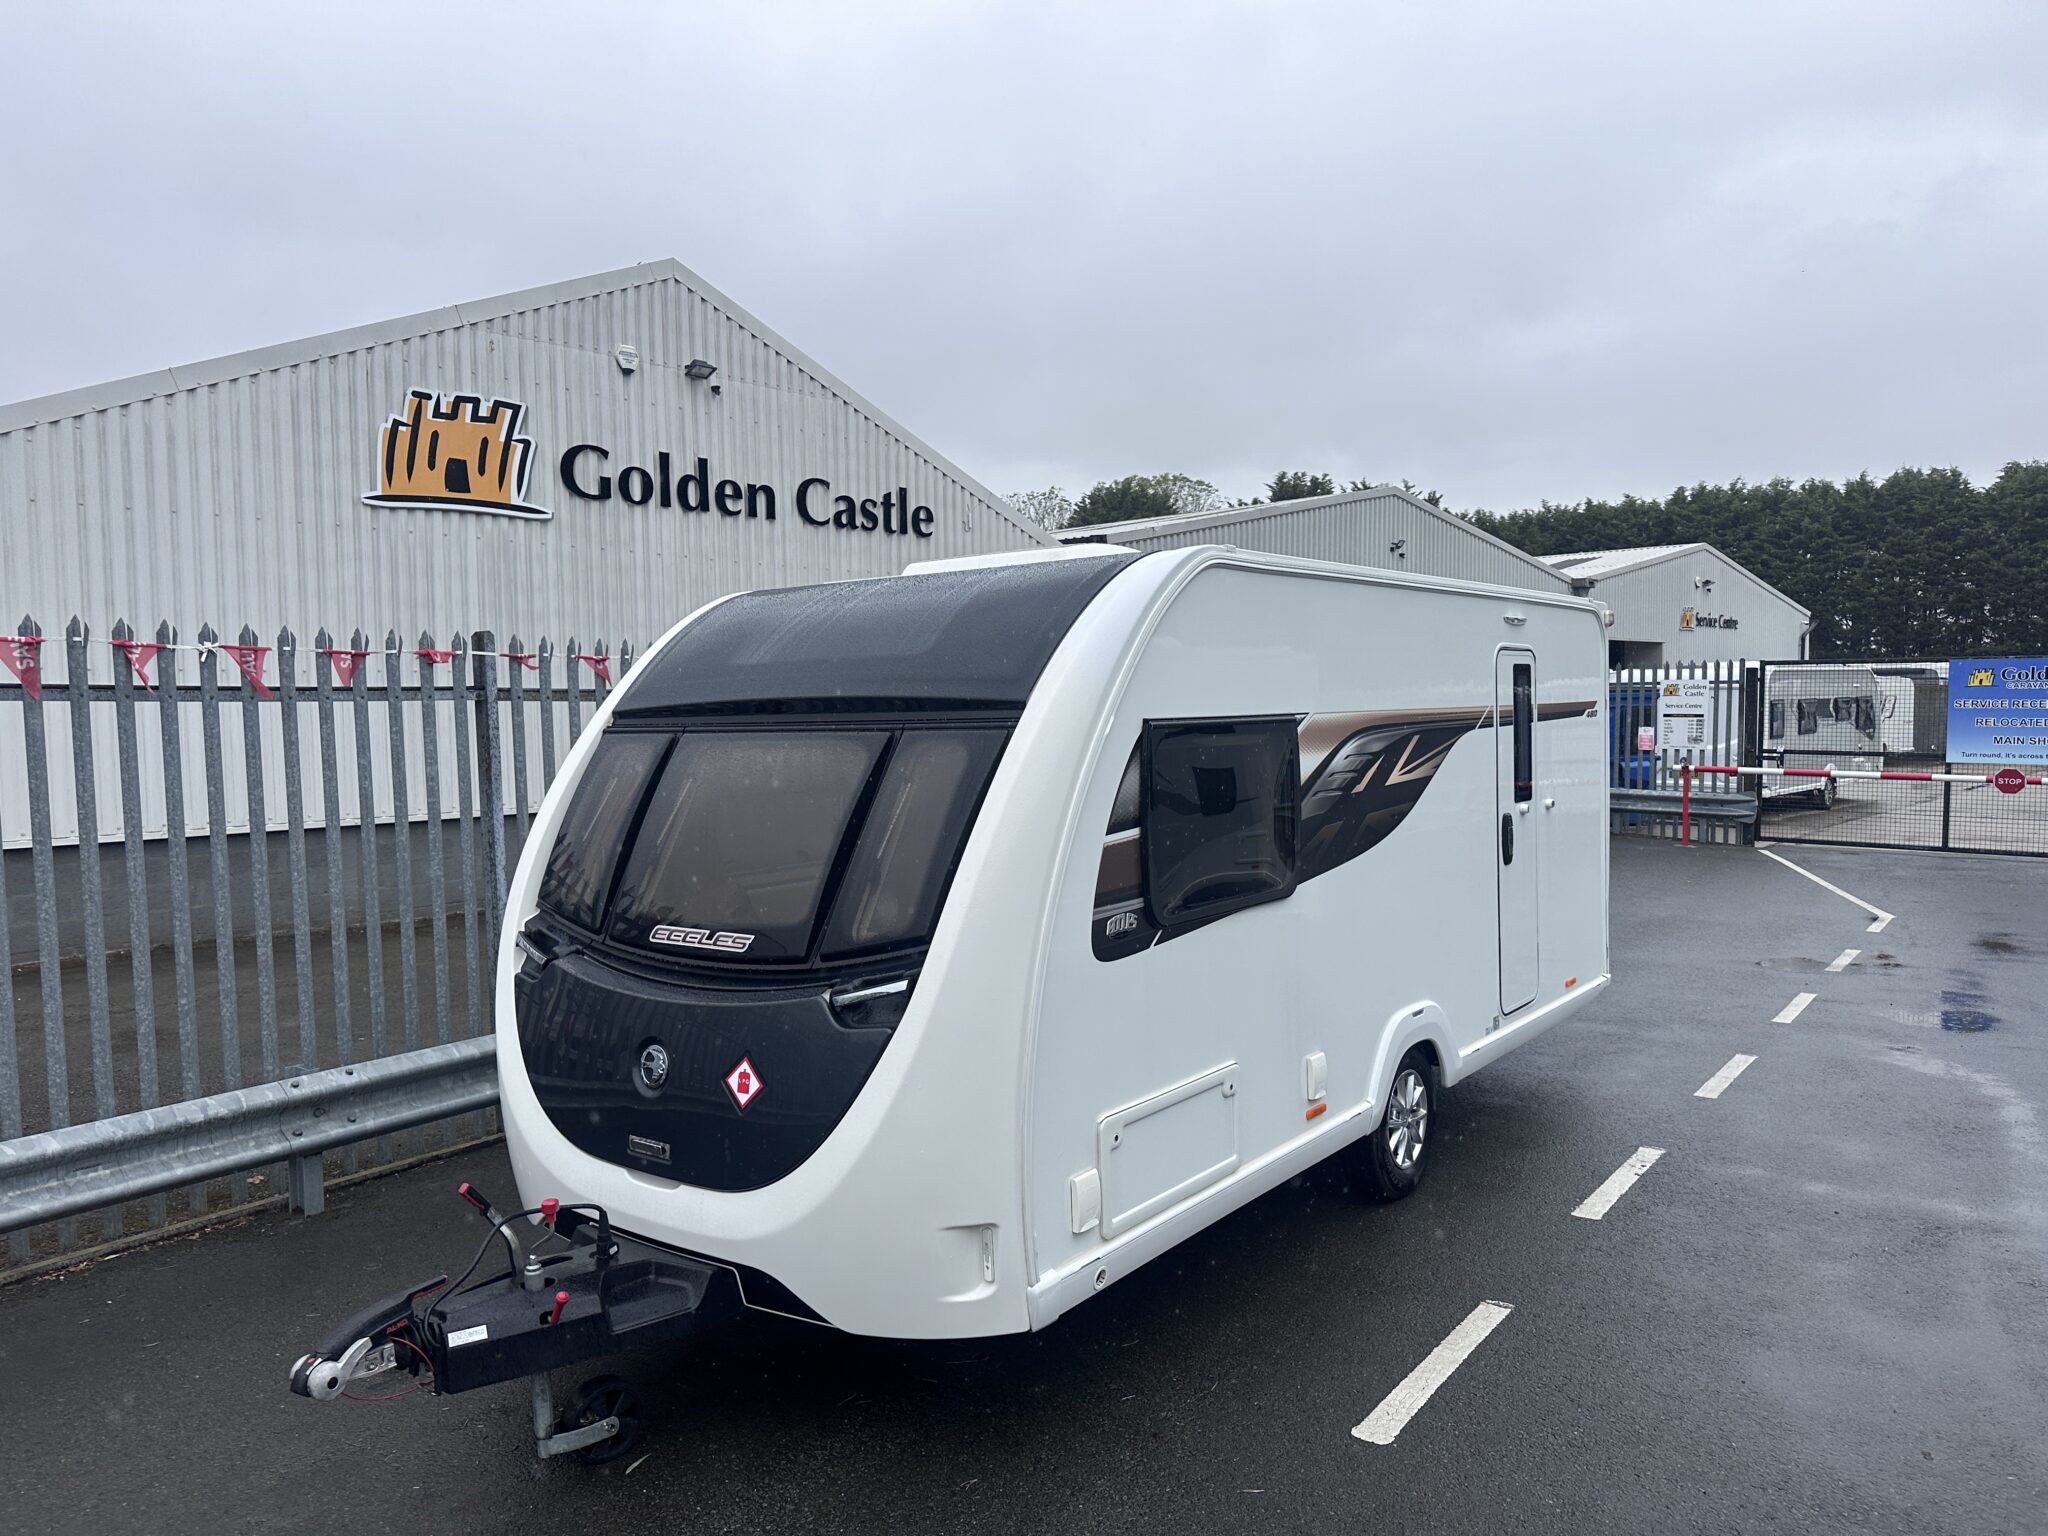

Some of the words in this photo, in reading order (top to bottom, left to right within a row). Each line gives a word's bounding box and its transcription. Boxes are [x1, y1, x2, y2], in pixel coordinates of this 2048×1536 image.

[560, 444, 776, 520] Golden
[796, 477, 934, 538] Castle
[1695, 611, 1718, 628] Service
[1718, 614, 1738, 630] Centre
[1683, 683, 1707, 691] Golden
[1954, 699, 2008, 709] SERVICE
[1993, 736, 2026, 746] MAIN
[2029, 736, 2048, 746] SH
[1998, 777, 2022, 785] STOP
[649, 925, 755, 953] ECCLES
